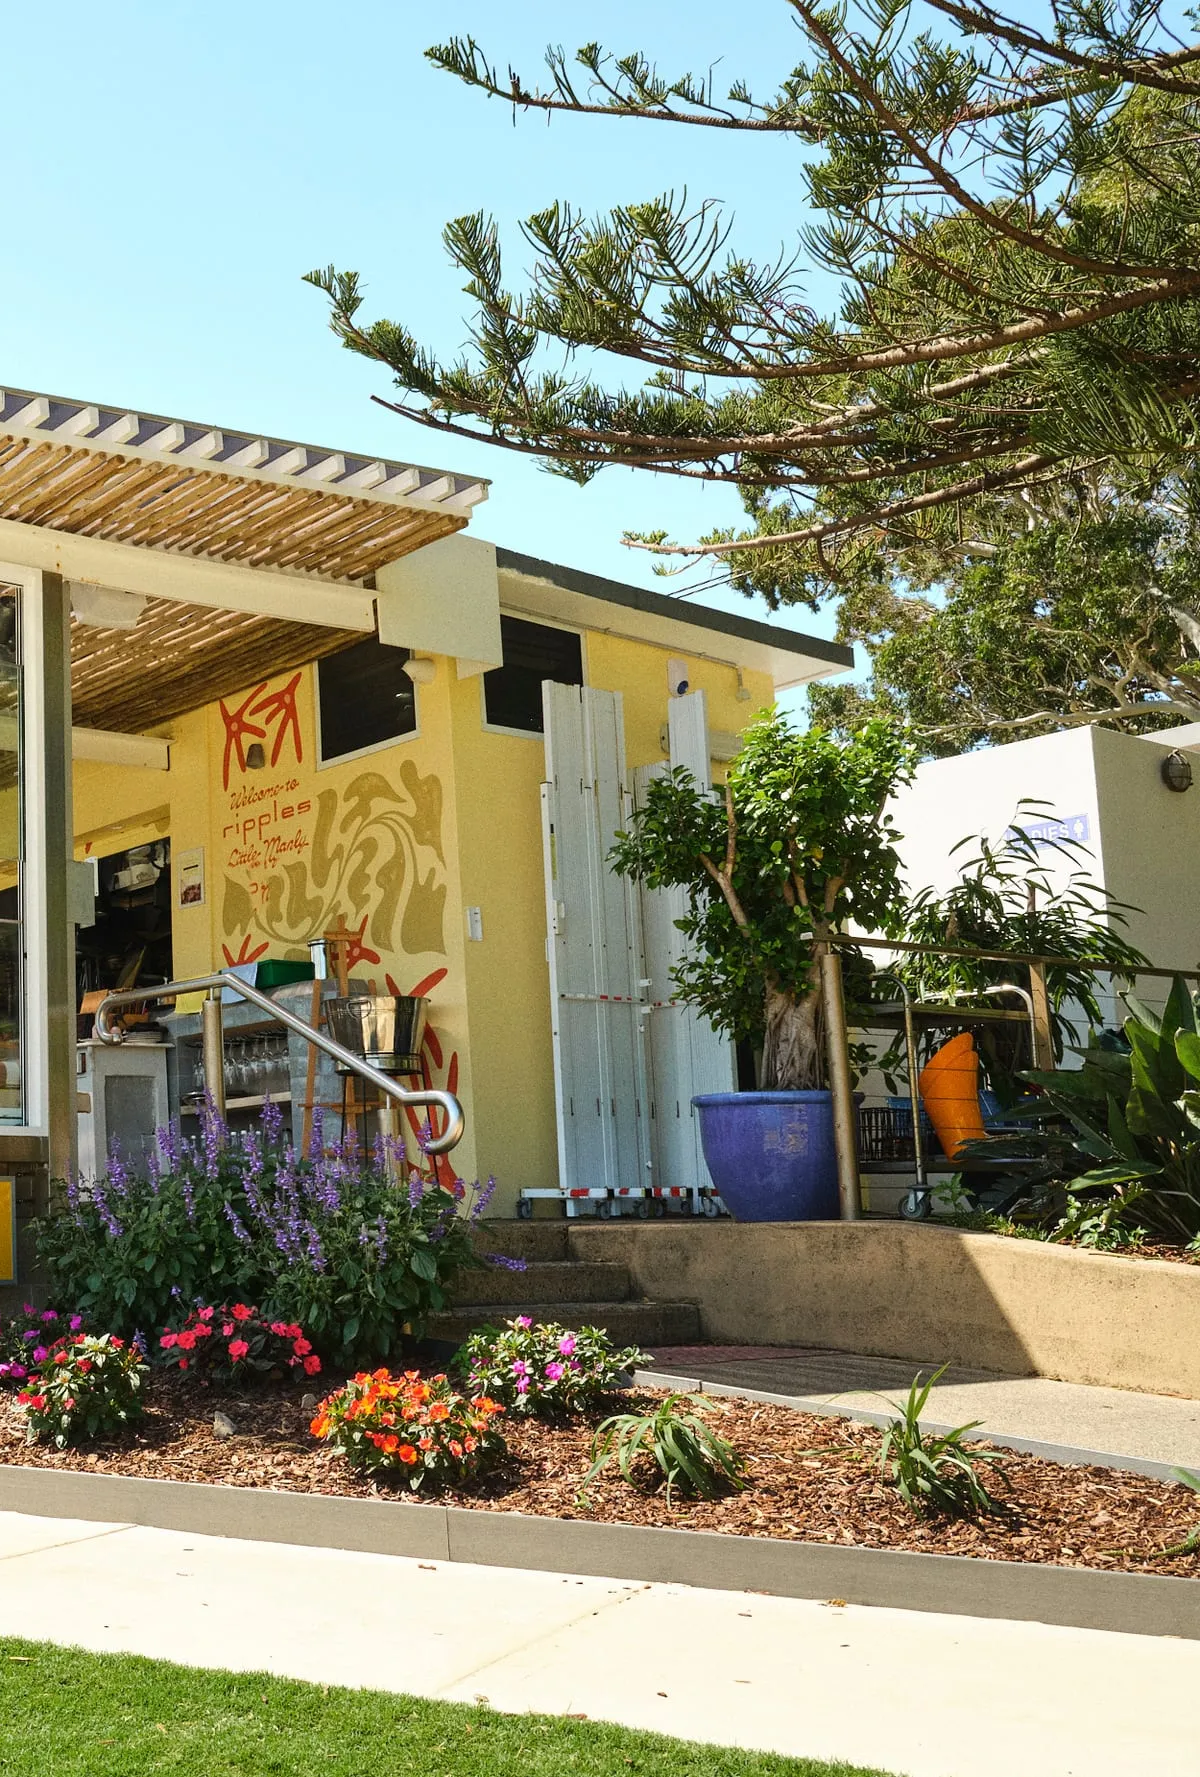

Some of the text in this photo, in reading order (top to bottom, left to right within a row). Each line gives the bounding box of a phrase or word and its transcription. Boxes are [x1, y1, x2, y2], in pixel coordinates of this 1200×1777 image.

[230, 778, 300, 810] Welcome to
[223, 799, 311, 846] ripples
[227, 829, 310, 869] Little Manly
